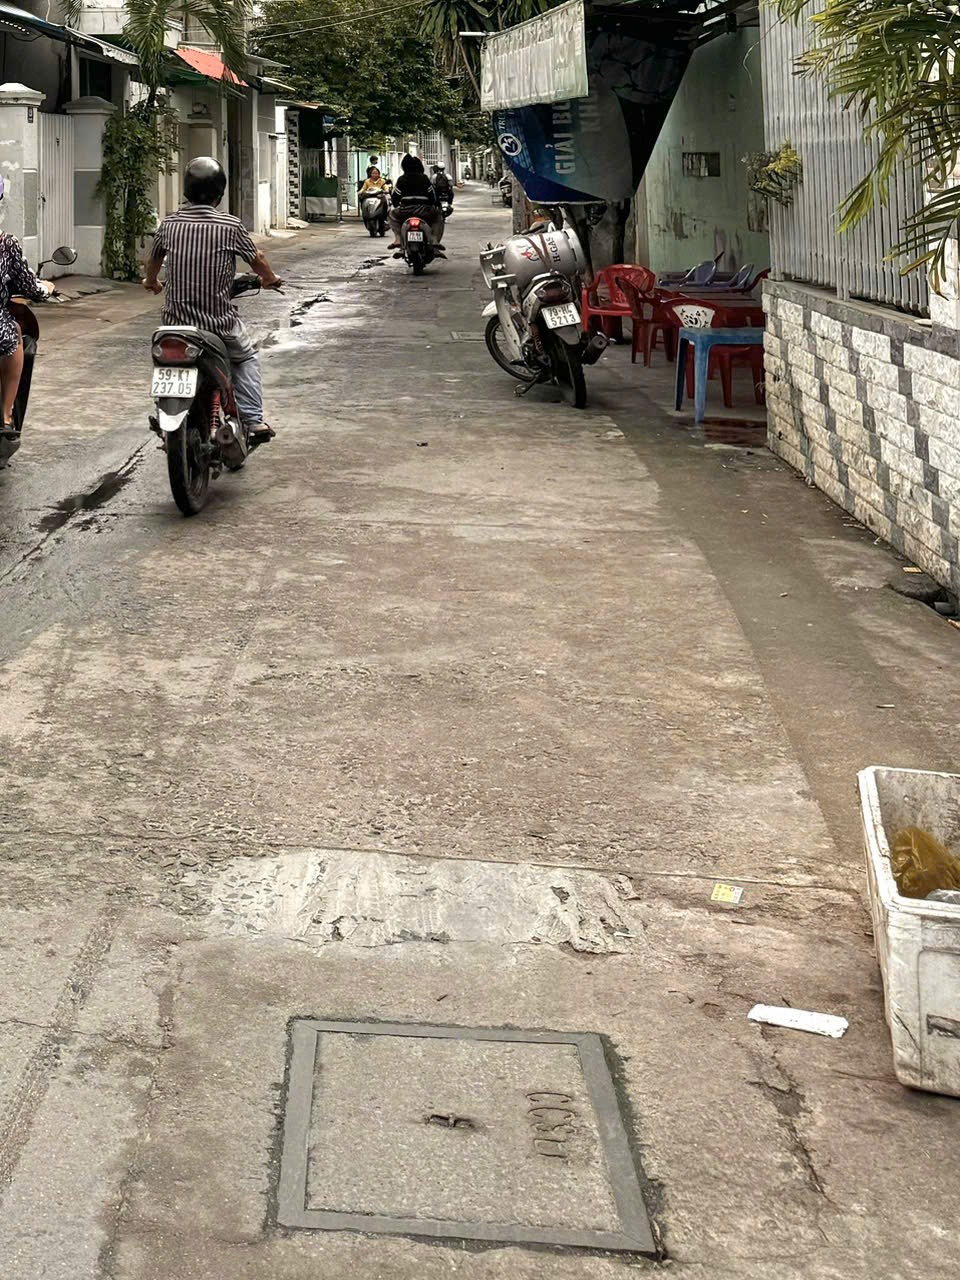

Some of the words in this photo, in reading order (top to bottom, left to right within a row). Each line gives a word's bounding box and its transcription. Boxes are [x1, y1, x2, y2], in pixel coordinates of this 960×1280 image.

[545, 132, 577, 175] GIẢI
[550, 313, 577, 326] 5213
[158, 368, 191, 381] 59-K1
[152, 381, 193, 395] 237.05
